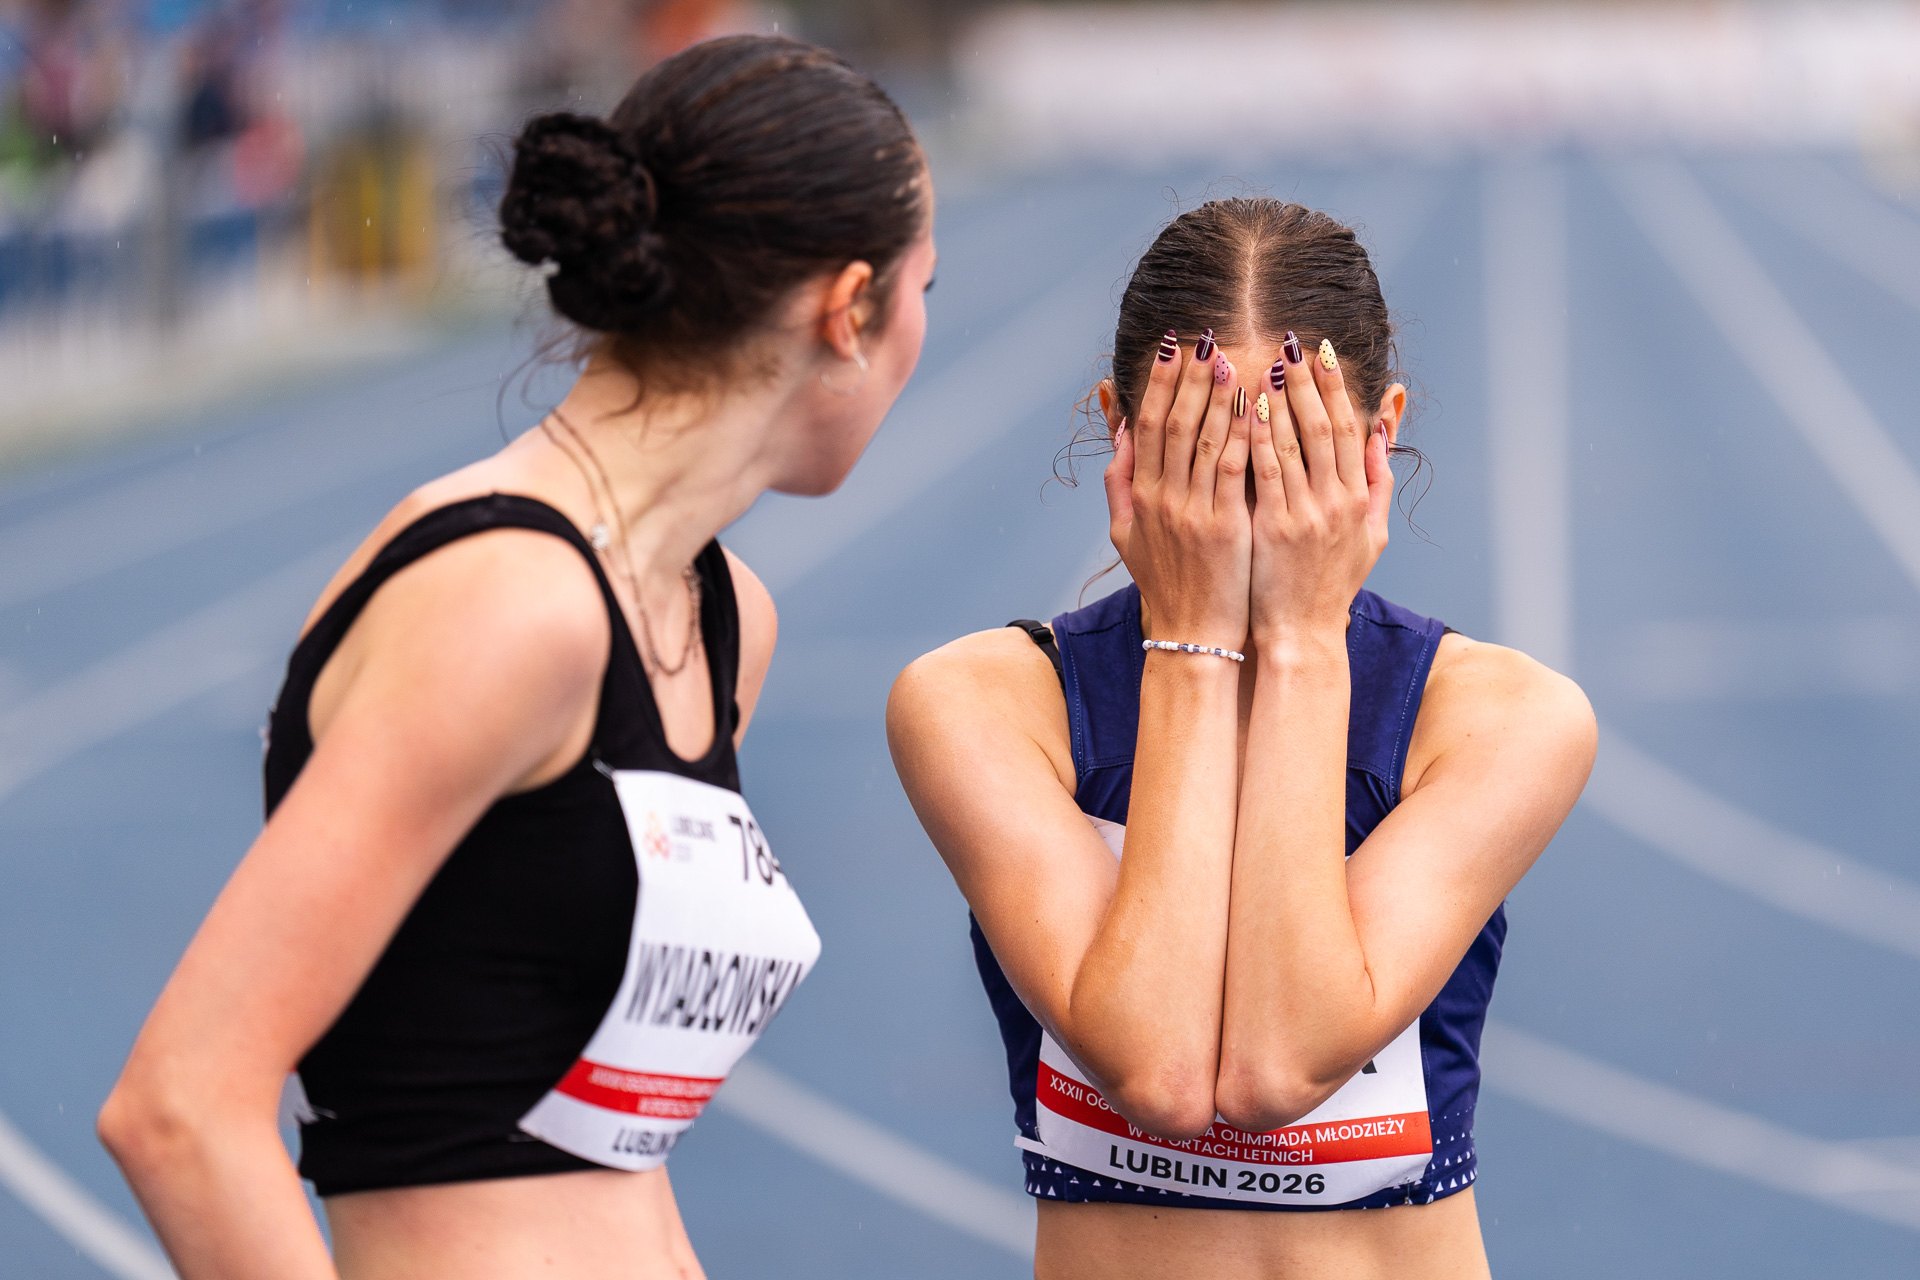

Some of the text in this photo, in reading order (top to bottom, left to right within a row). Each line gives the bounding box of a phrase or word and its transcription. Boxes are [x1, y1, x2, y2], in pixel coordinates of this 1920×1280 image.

[1050, 1074, 1083, 1102] XXXII
[1128, 1122, 1143, 1138] W
[1243, 1148, 1313, 1163] LETNICH
[1220, 1129, 1312, 1147] OLIMPIADA
[1316, 1117, 1406, 1143] MŁODZIEŻY
[1109, 1144, 1325, 1195] LUBLIN 2026
